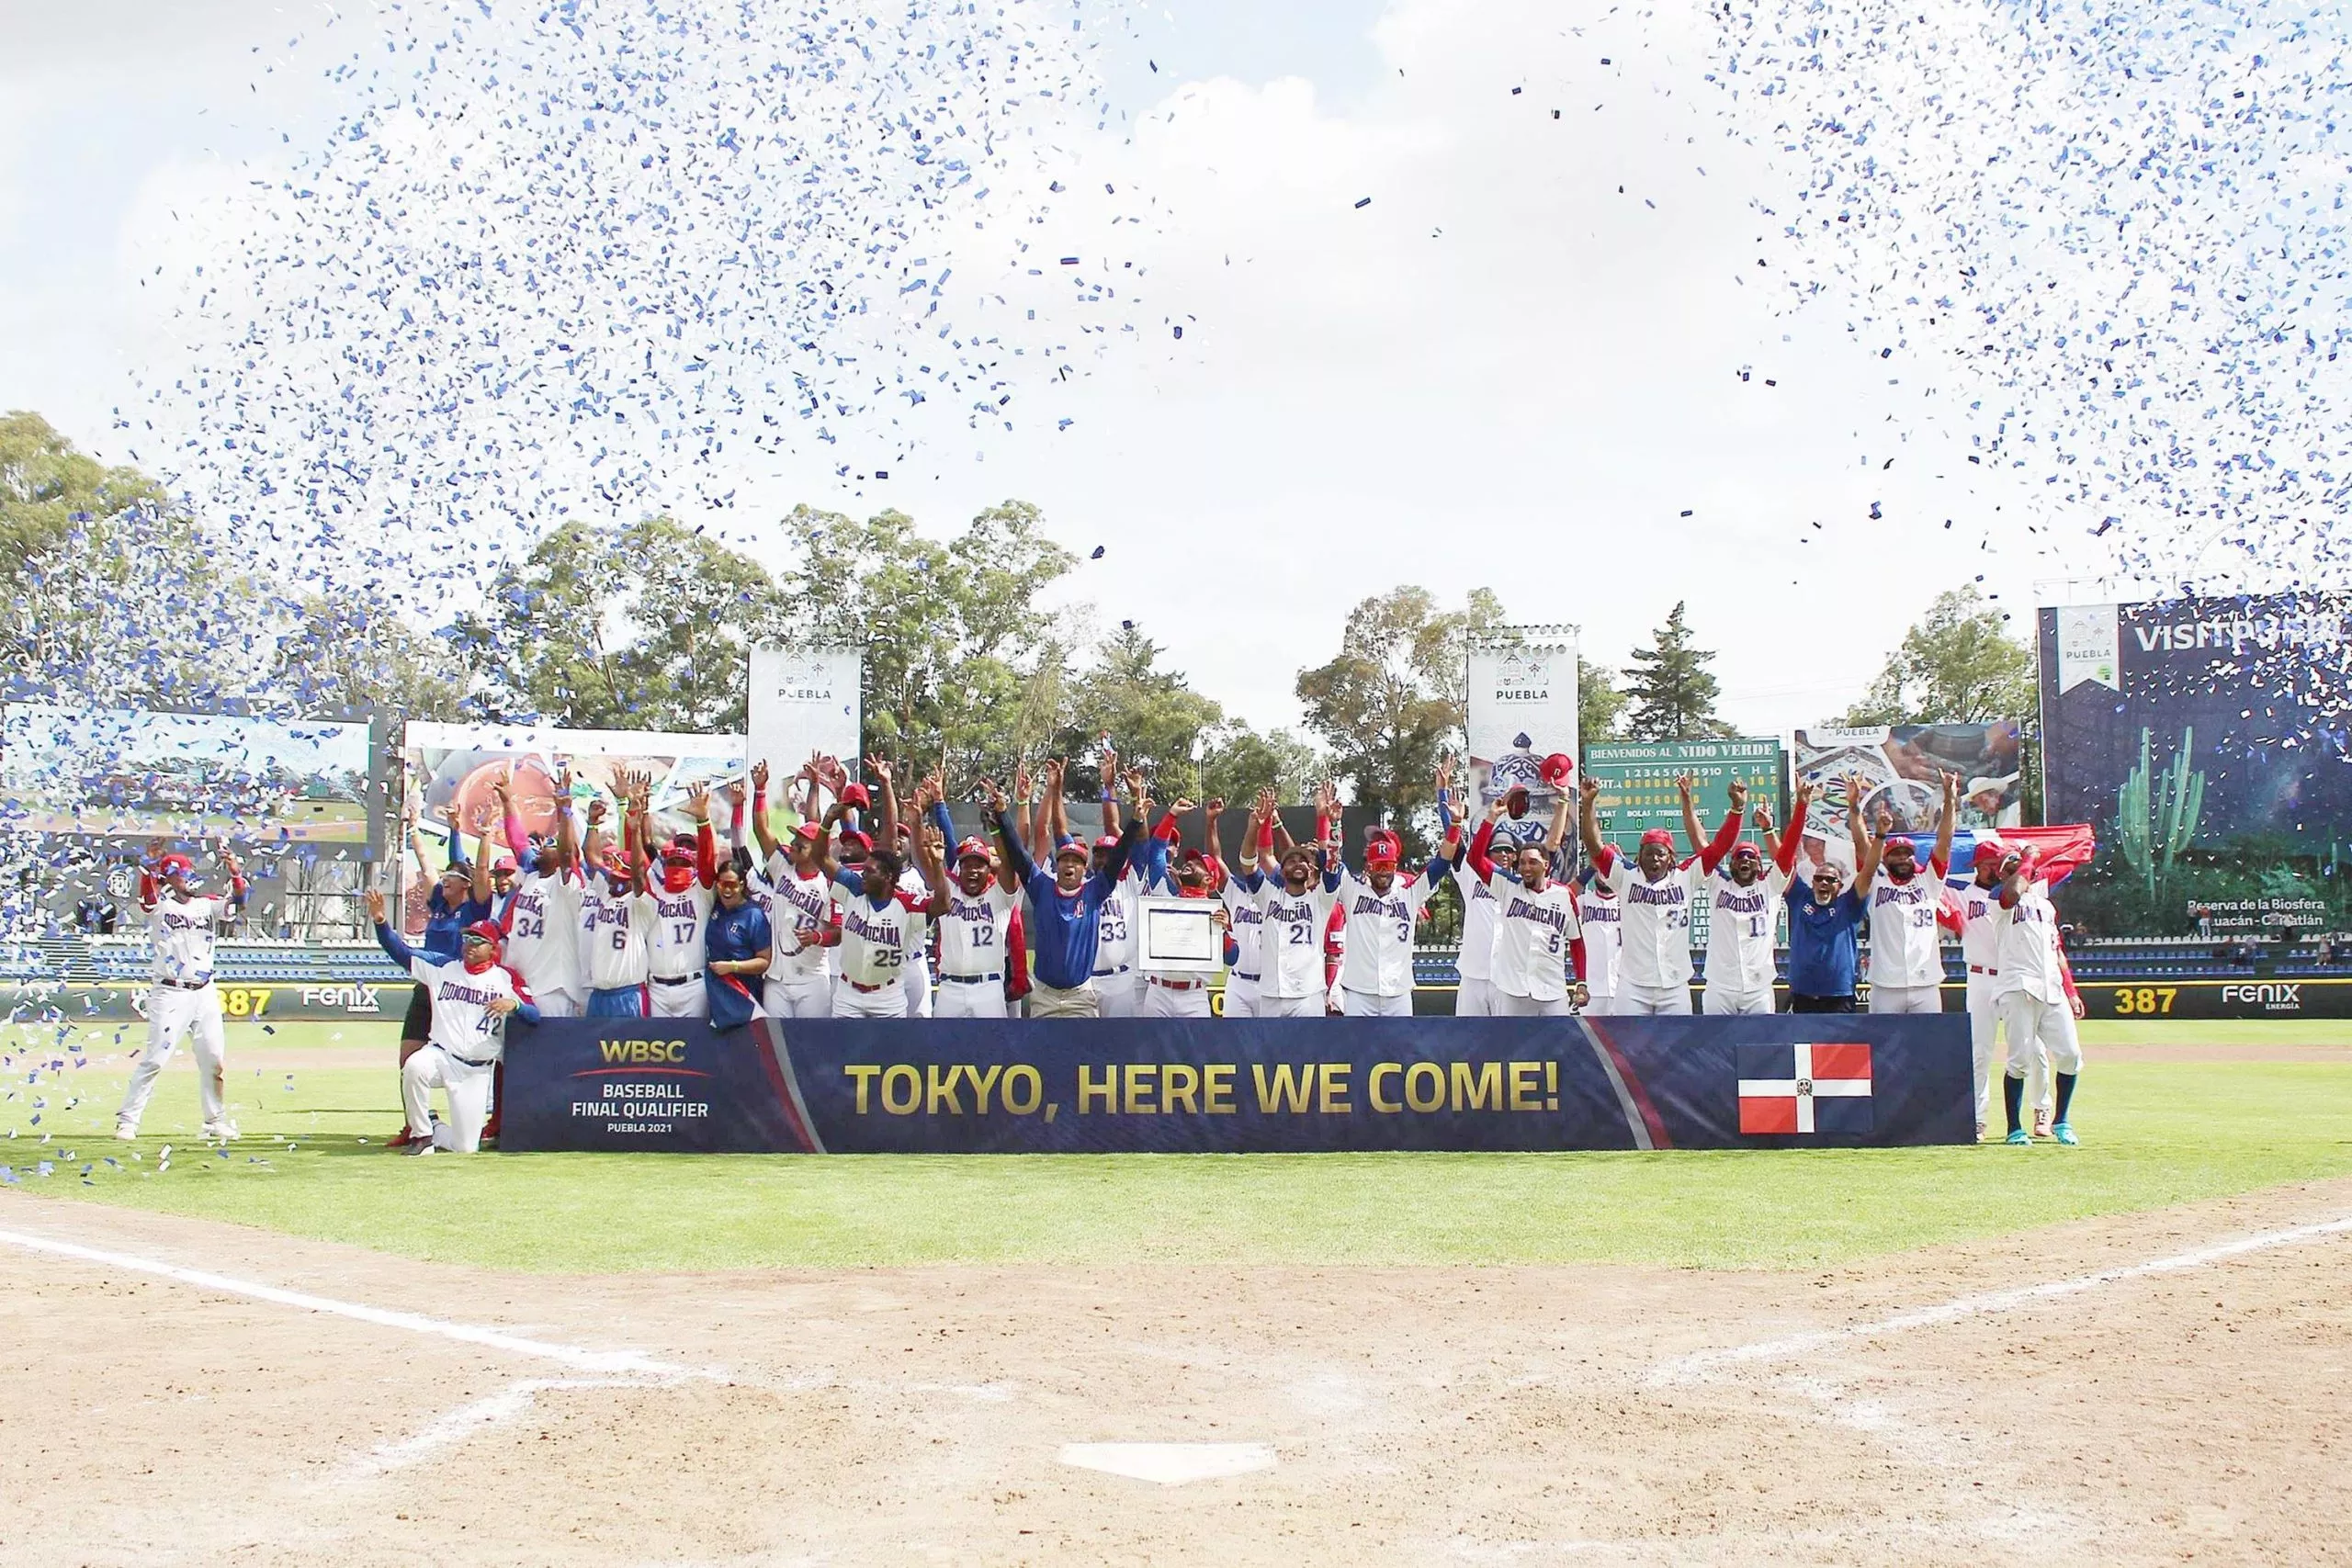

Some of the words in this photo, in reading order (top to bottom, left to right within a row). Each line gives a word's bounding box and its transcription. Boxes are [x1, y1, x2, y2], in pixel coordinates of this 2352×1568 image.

[2066, 649, 2110, 659] PUEBLA
[1496, 690, 1548, 700] PUEBLA
[1836, 728, 1880, 737] PUEBLA
[1590, 748, 1655, 760] BIENVENIDOS
[1658, 748, 1672, 758] AL
[1678, 745, 1717, 758] NIDO
[1721, 743, 1773, 757] VERDE
[1644, 769, 1650, 777] 3
[1652, 769, 1660, 777] 4
[1663, 768, 1669, 776] 5
[1702, 767, 1708, 776] 9
[1710, 767, 1722, 776] 10
[1752, 766, 1759, 774] H
[1770, 766, 1777, 774] E
[1626, 809, 1651, 818] BOLAS
[1378, 843, 1387, 854] R
[2188, 900, 2238, 910] Reserva
[2240, 898, 2256, 910] de
[2257, 898, 2270, 909] la
[2271, 897, 2325, 909] Biosfera
[1913, 908, 1933, 928] 39
[2211, 914, 2253, 926] uacán
[517, 918, 544, 939] 34
[673, 922, 695, 944] 17
[972, 926, 993, 947] 12
[1101, 921, 1126, 942] 33
[1290, 924, 1312, 944] 21
[1397, 922, 1409, 942] 3
[612, 930, 626, 950] 6
[1548, 933, 1560, 953] 5
[874, 949, 902, 967] 25
[217, 988, 272, 1016] 387
[2115, 987, 2177, 1014] 387
[475, 1016, 503, 1036] 42
[599, 1039, 686, 1063] WBSC
[603, 1084, 684, 1099] BASEBALL
[844, 1063, 1058, 1124] TOKYO,
[1079, 1064, 1237, 1114] HERE
[1251, 1062, 1352, 1114] WE
[1368, 1060, 1560, 1114] COME!
[571, 1102, 619, 1118] FINAL
[623, 1102, 708, 1120] QUALIFIER
[607, 1122, 646, 1133] PUEBLA
[647, 1122, 673, 1133] 2021
